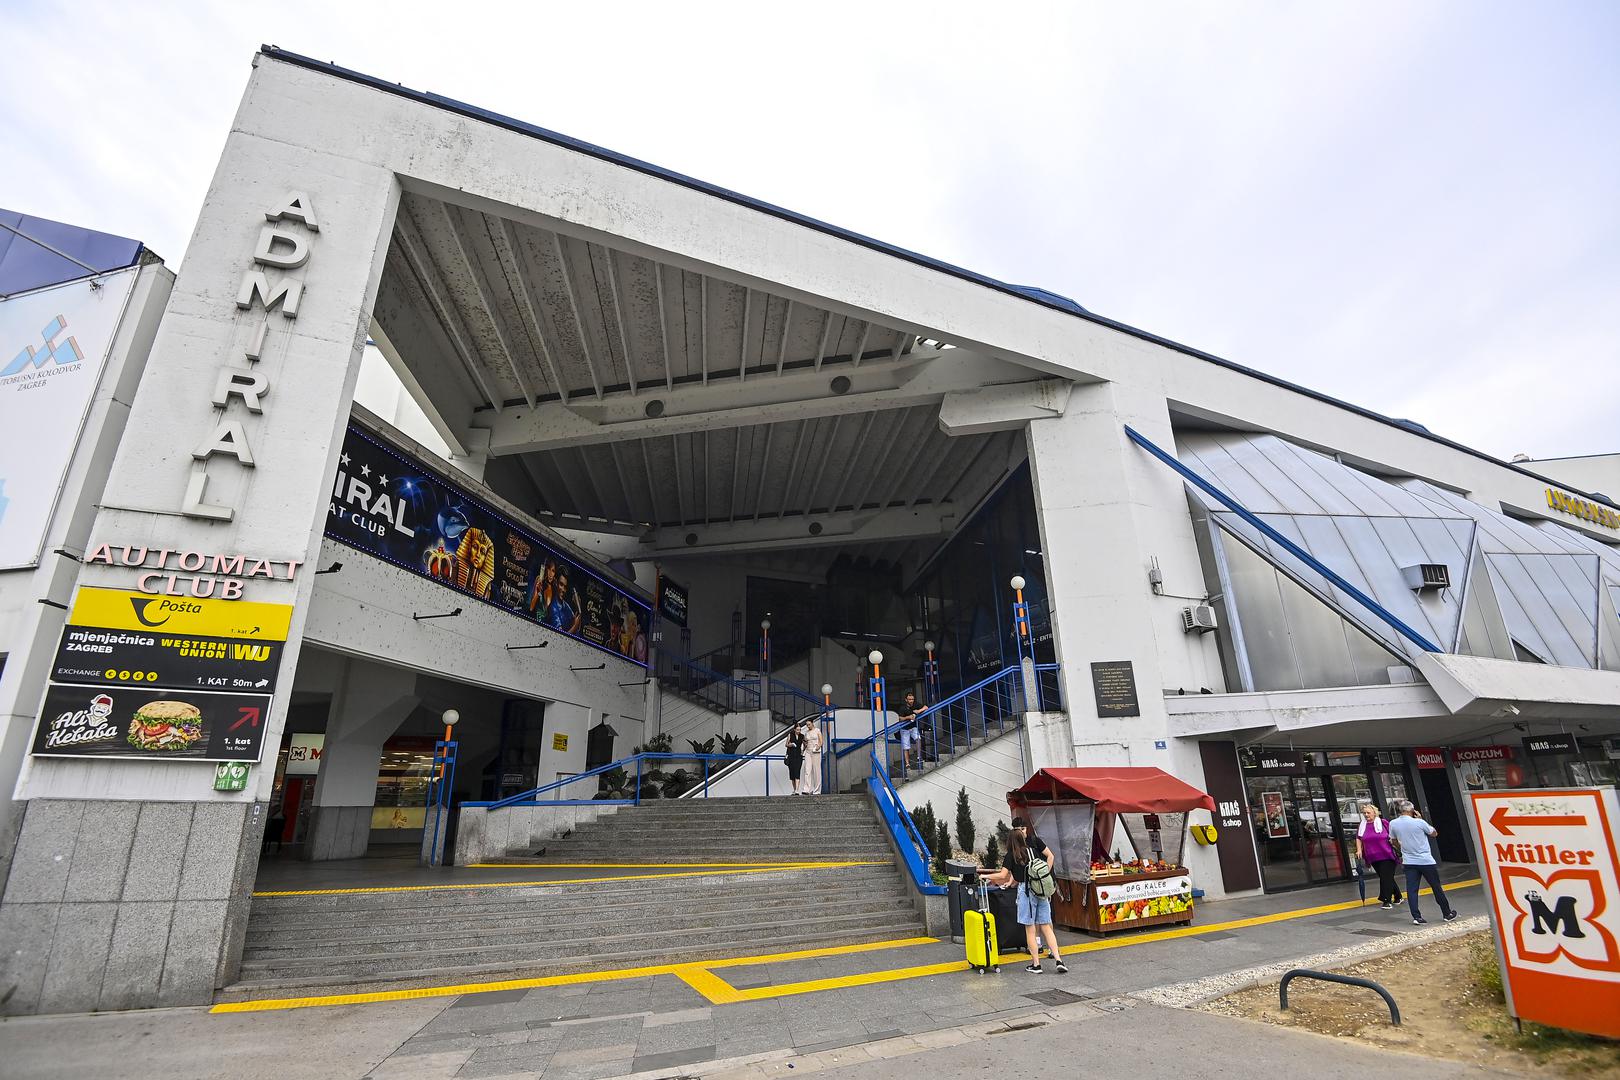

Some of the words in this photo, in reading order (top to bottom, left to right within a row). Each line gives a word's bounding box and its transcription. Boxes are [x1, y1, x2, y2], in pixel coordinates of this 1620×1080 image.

[182, 190, 320, 522] ADMIRAL
[37, 363, 82, 379] KOLODVOR
[17, 379, 47, 391] ZAGREB
[351, 513, 386, 537] CLUB
[86, 543, 304, 580] AUTOMAT
[137, 571, 244, 600] CLUB
[159, 599, 202, 613] Pošta
[66, 643, 113, 654] ZAGREB
[179, 648, 226, 659] UNION
[69, 631, 155, 647] mjenjačnica
[161, 638, 227, 651] WESTERN
[234, 643, 271, 662] WU
[57, 668, 102, 677] EXCHANGE
[197, 677, 204, 685] 1.
[208, 678, 228, 686] KAT
[232, 678, 253, 687] 50m
[54, 710, 89, 729] Ali
[48, 723, 118, 746] Kebaba
[1416, 754, 1443, 764] KONZUM
[1456, 750, 1503, 761] KONZUM
[1494, 843, 1595, 865] Müller
[1524, 893, 1587, 938] M
